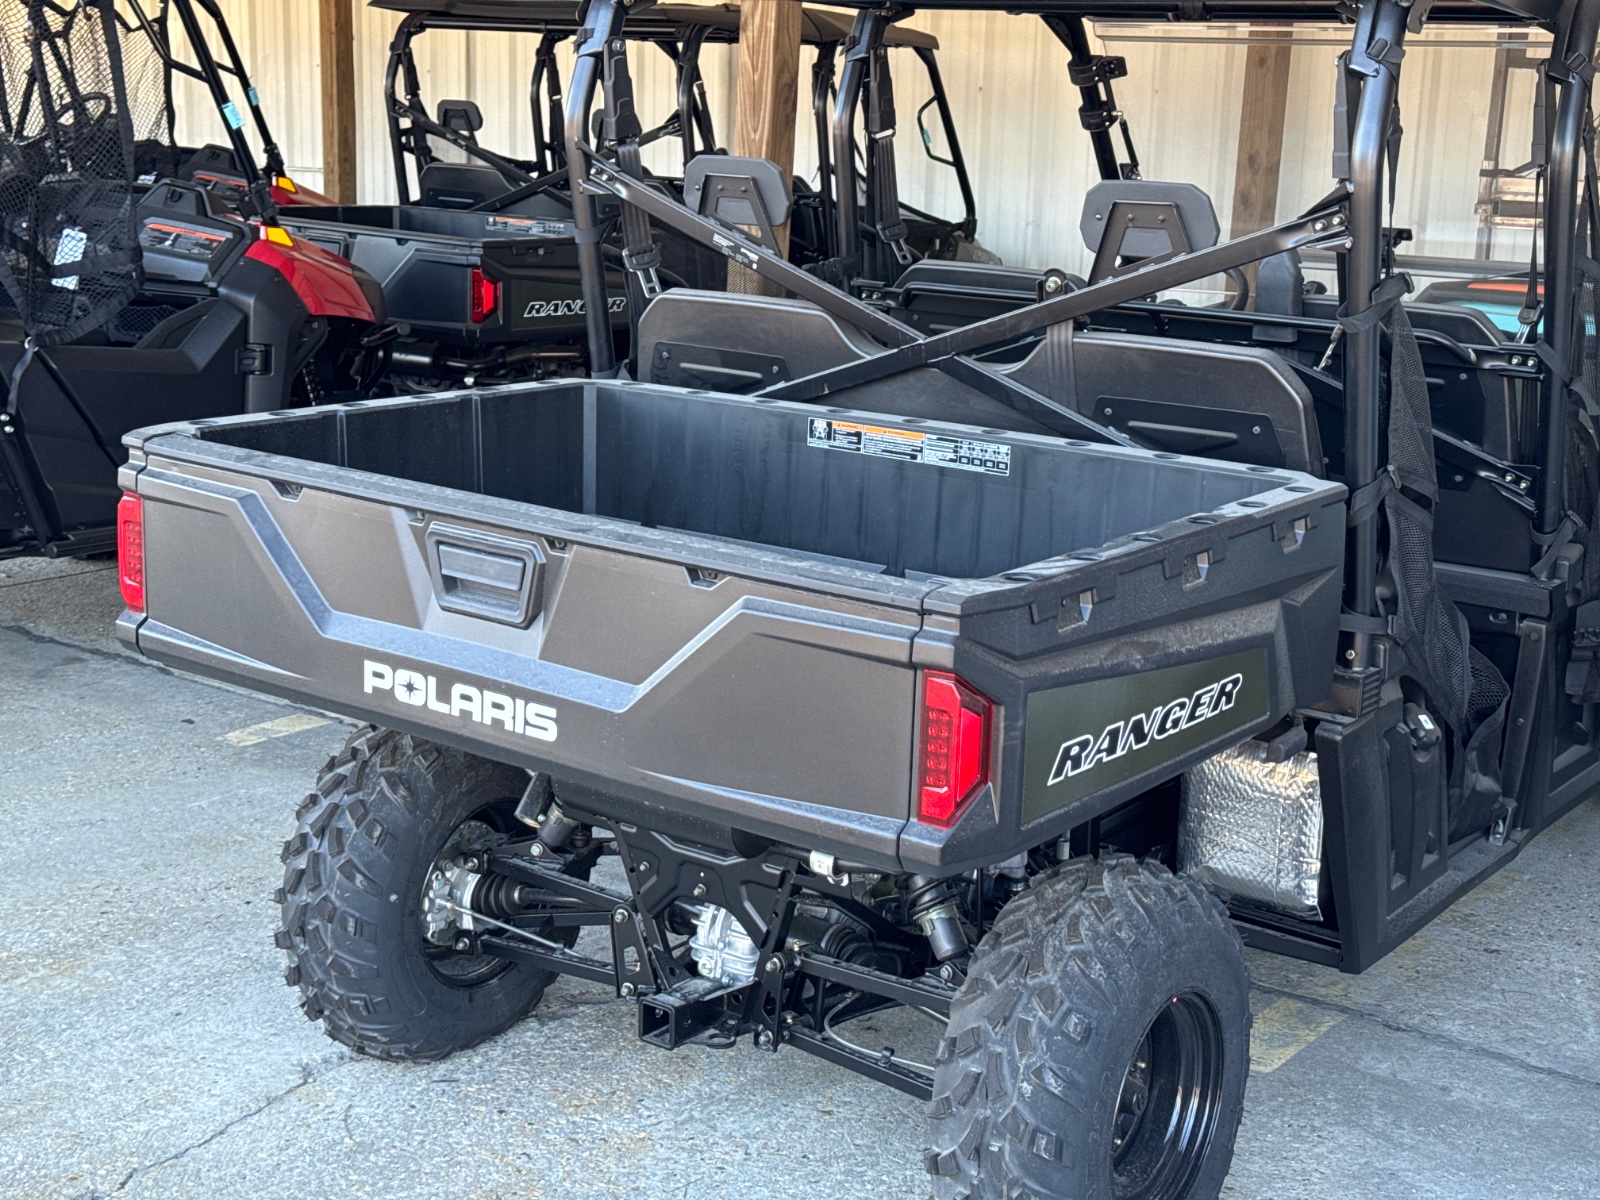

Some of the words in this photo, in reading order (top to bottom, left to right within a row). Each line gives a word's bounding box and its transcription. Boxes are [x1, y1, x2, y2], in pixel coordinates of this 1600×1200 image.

[523, 297, 627, 317] RANR
[364, 660, 558, 742] POLARIS
[1047, 673, 1243, 787] RANGER
